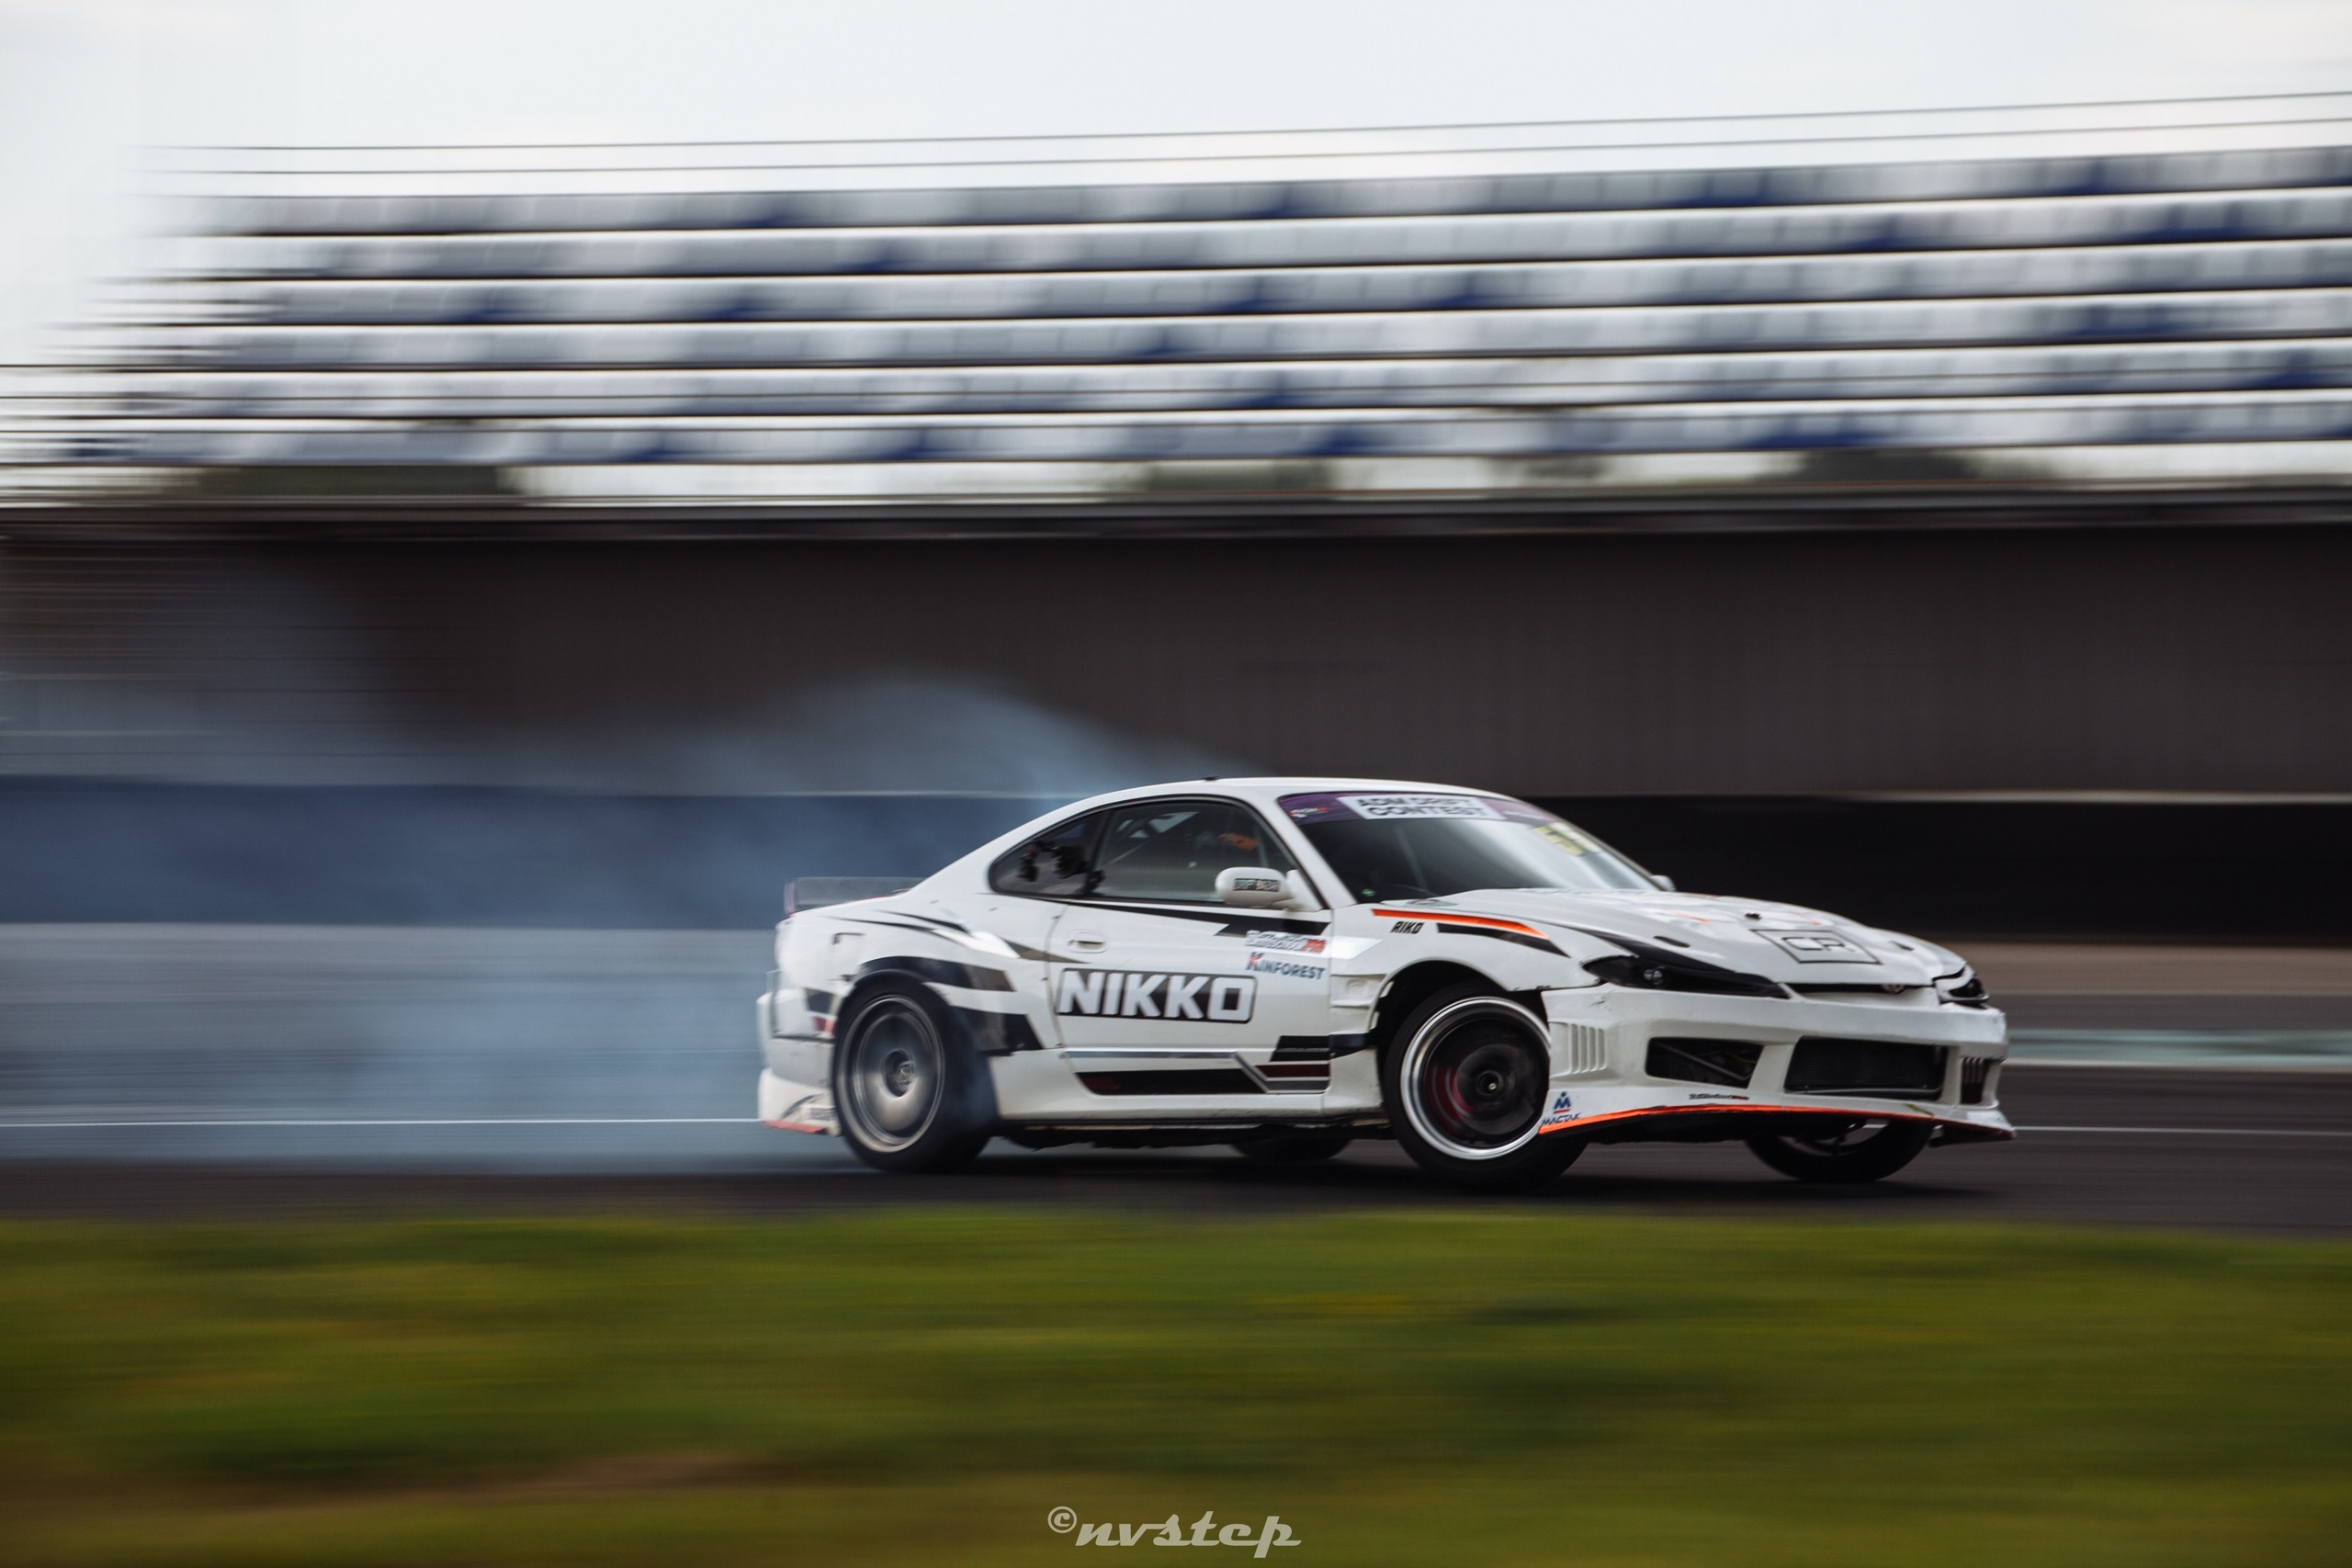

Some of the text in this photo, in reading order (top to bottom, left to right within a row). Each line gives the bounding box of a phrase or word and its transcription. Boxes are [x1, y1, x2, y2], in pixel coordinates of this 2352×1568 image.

[1389, 920, 1425, 935] RIKO
[1245, 952, 1326, 980] KINFOREST
[1058, 970, 1256, 1022] NIKKO
